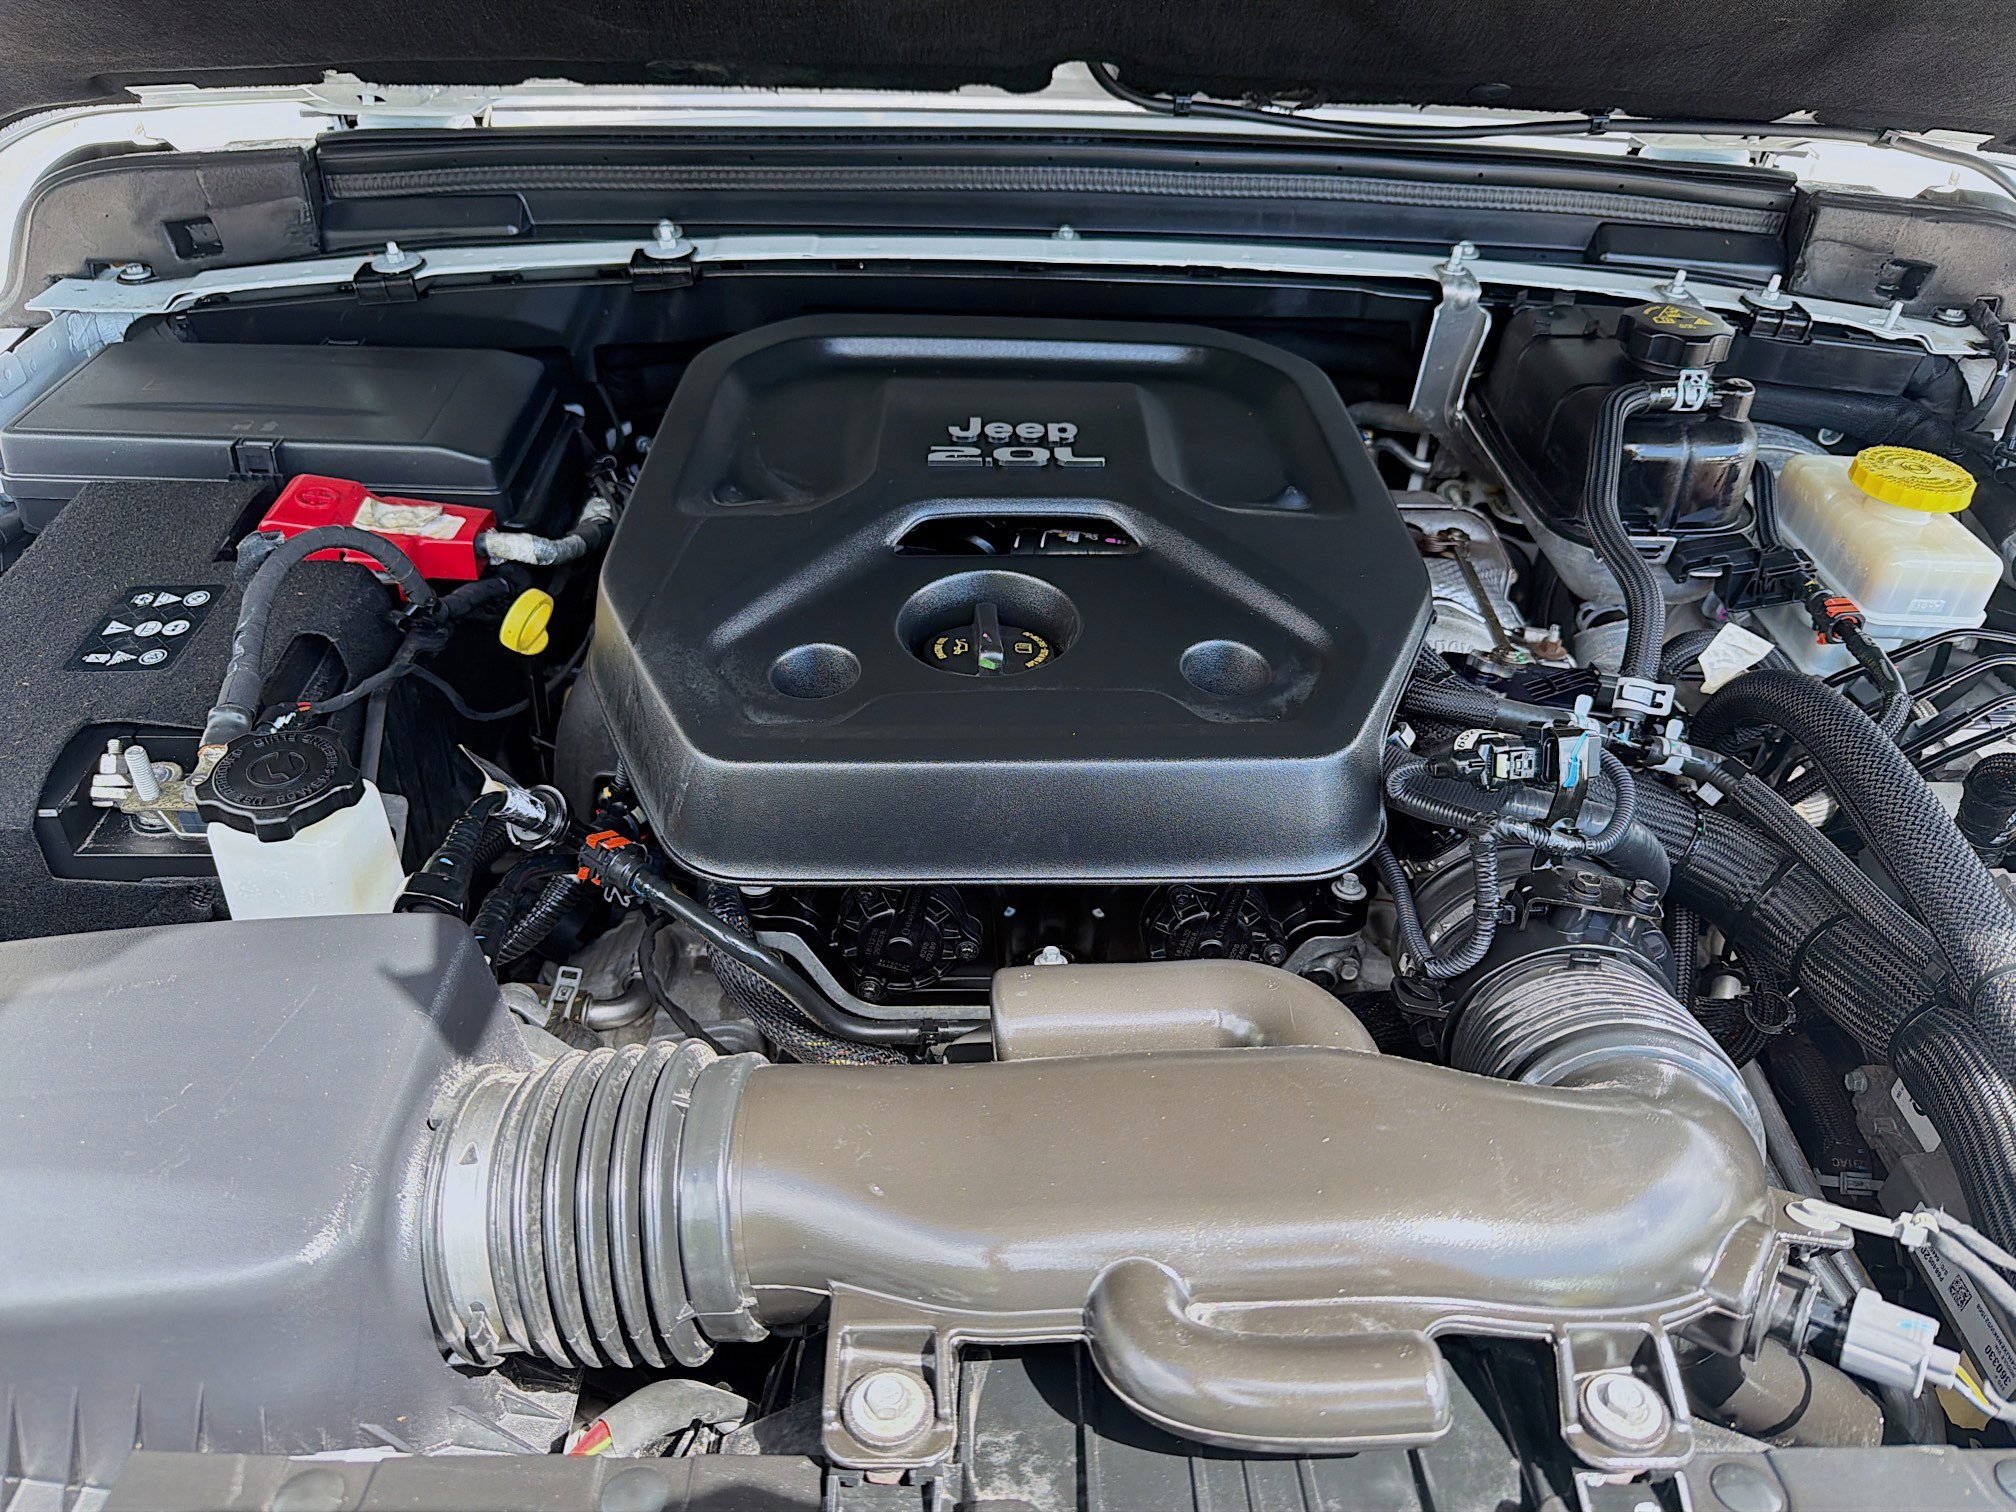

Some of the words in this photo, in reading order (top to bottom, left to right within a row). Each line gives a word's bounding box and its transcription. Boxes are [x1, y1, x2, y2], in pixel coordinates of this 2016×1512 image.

[948, 416, 1078, 446] Jeep
[927, 446, 1105, 467] 2.0L
[253, 733, 297, 748] FLUID
[301, 734, 340, 774] STEERING
[215, 749, 243, 797] APPROVED
[235, 793, 264, 806] USE
[276, 773, 332, 804] POWER
[1984, 1344, 2011, 1386] 360330
